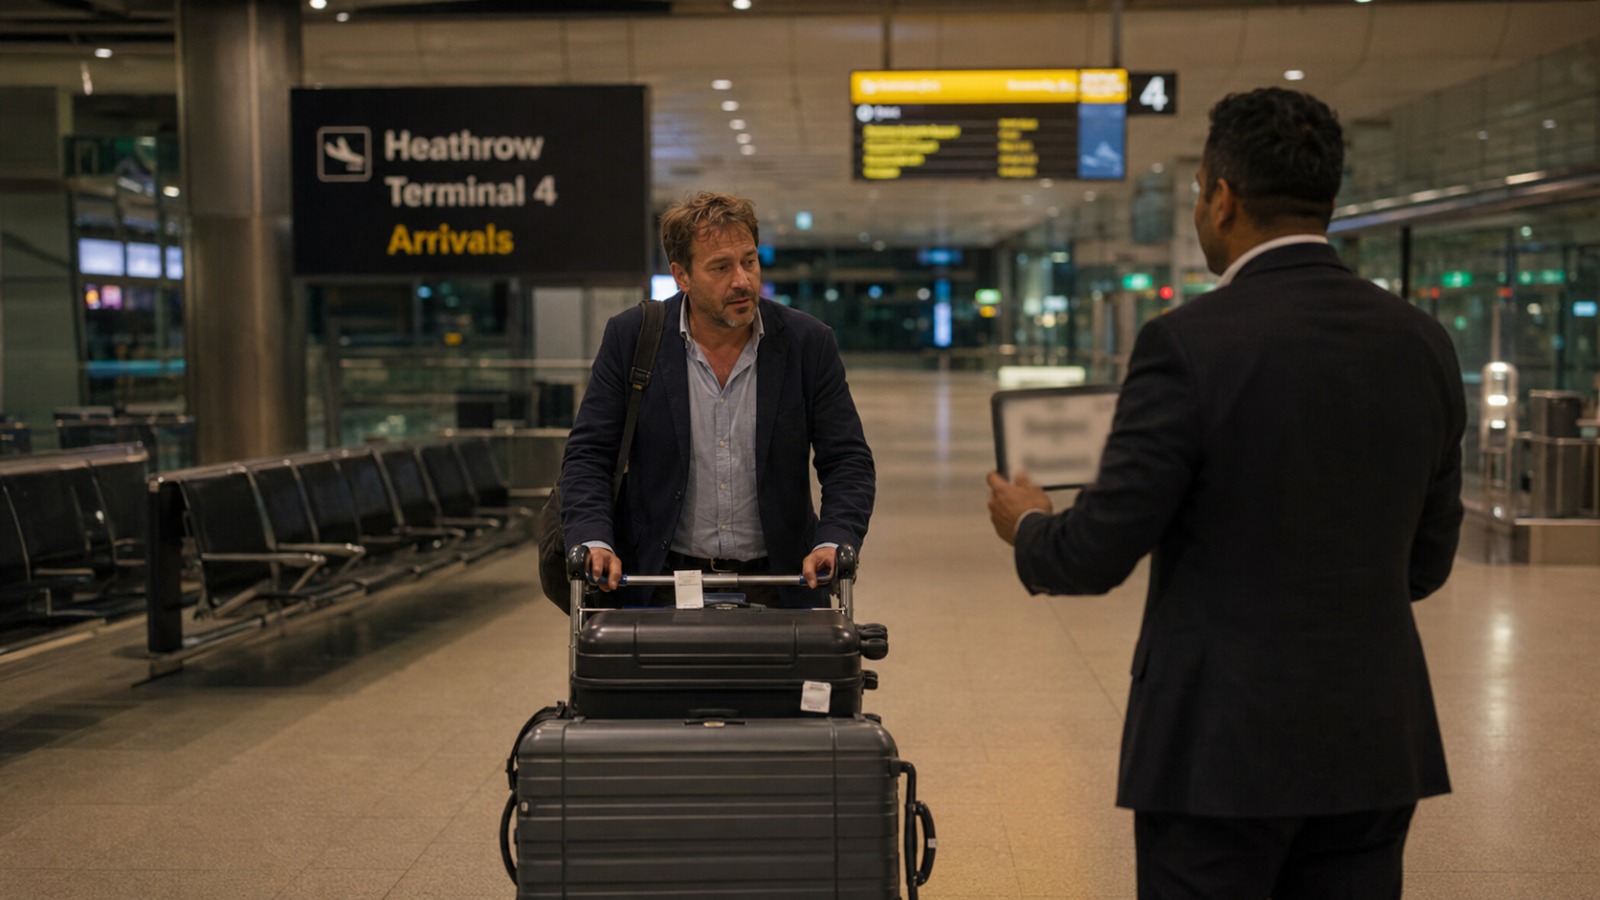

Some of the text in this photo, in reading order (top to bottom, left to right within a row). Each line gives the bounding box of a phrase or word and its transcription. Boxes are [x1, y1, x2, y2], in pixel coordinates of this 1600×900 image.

[1139, 76, 1168, 111] 4
[385, 130, 544, 161] Heathrow
[385, 175, 558, 207] Terminal 4
[387, 223, 514, 255] Arrivals
